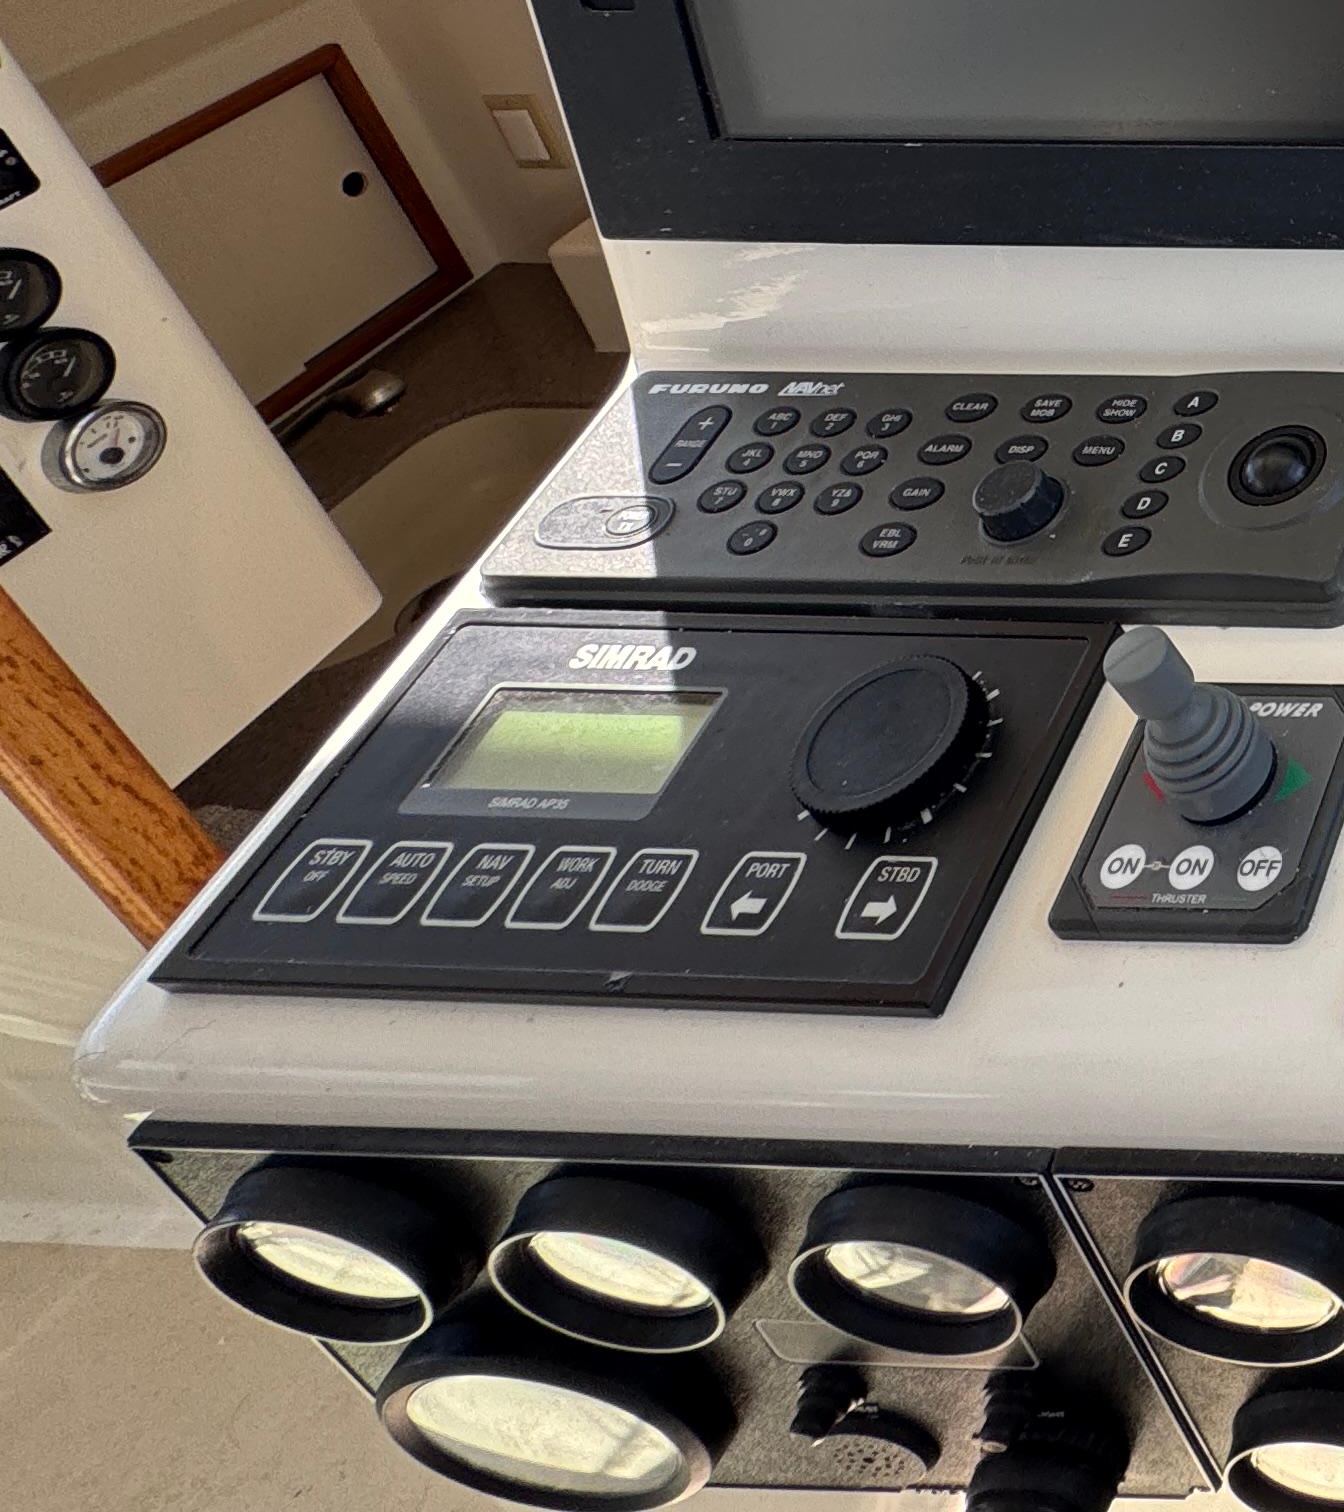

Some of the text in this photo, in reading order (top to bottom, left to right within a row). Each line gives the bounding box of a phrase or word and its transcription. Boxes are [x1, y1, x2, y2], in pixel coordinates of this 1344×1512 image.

[648, 384, 769, 394] FURUNO
[951, 401, 988, 411] CLEAR
[1034, 399, 1062, 408] SAVE
[1112, 399, 1137, 408] HIDE
[1187, 396, 1200, 409] A
[768, 413, 792, 421] ABC
[824, 413, 848, 421] DEF
[882, 414, 901, 422] GHI
[1103, 408, 1136, 417] SHOW
[1171, 429, 1184, 442] B
[924, 444, 964, 453] ALARM
[1008, 445, 1034, 455] DISP
[1081, 445, 1114, 456] MENU
[1155, 462, 1167, 475] C
[1136, 498, 1151, 510] D
[873, 540, 898, 548] VRM
[1119, 535, 1133, 548] E
[569, 644, 697, 670] SIMRAD
[488, 797, 538, 808] SIMRAD
[309, 849, 355, 865] STBY
[390, 853, 436, 868] AUTO
[475, 855, 514, 870] NAV
[556, 857, 600, 872] WORK
[638, 859, 683, 875] TURN
[1108, 858, 1140, 874] ON
[1176, 859, 1208, 875] ON
[1239, 860, 1281, 877] OFF
[303, 870, 329, 882] OFF
[745, 863, 789, 879] PORT
[877, 867, 921, 882] STBD
[378, 872, 418, 885] SPEED
[462, 875, 500, 887] SETUP
[551, 878, 578, 889] ADJ
[625, 880, 668, 892] DODGE
[1151, 893, 1206, 905] THRUSTER
